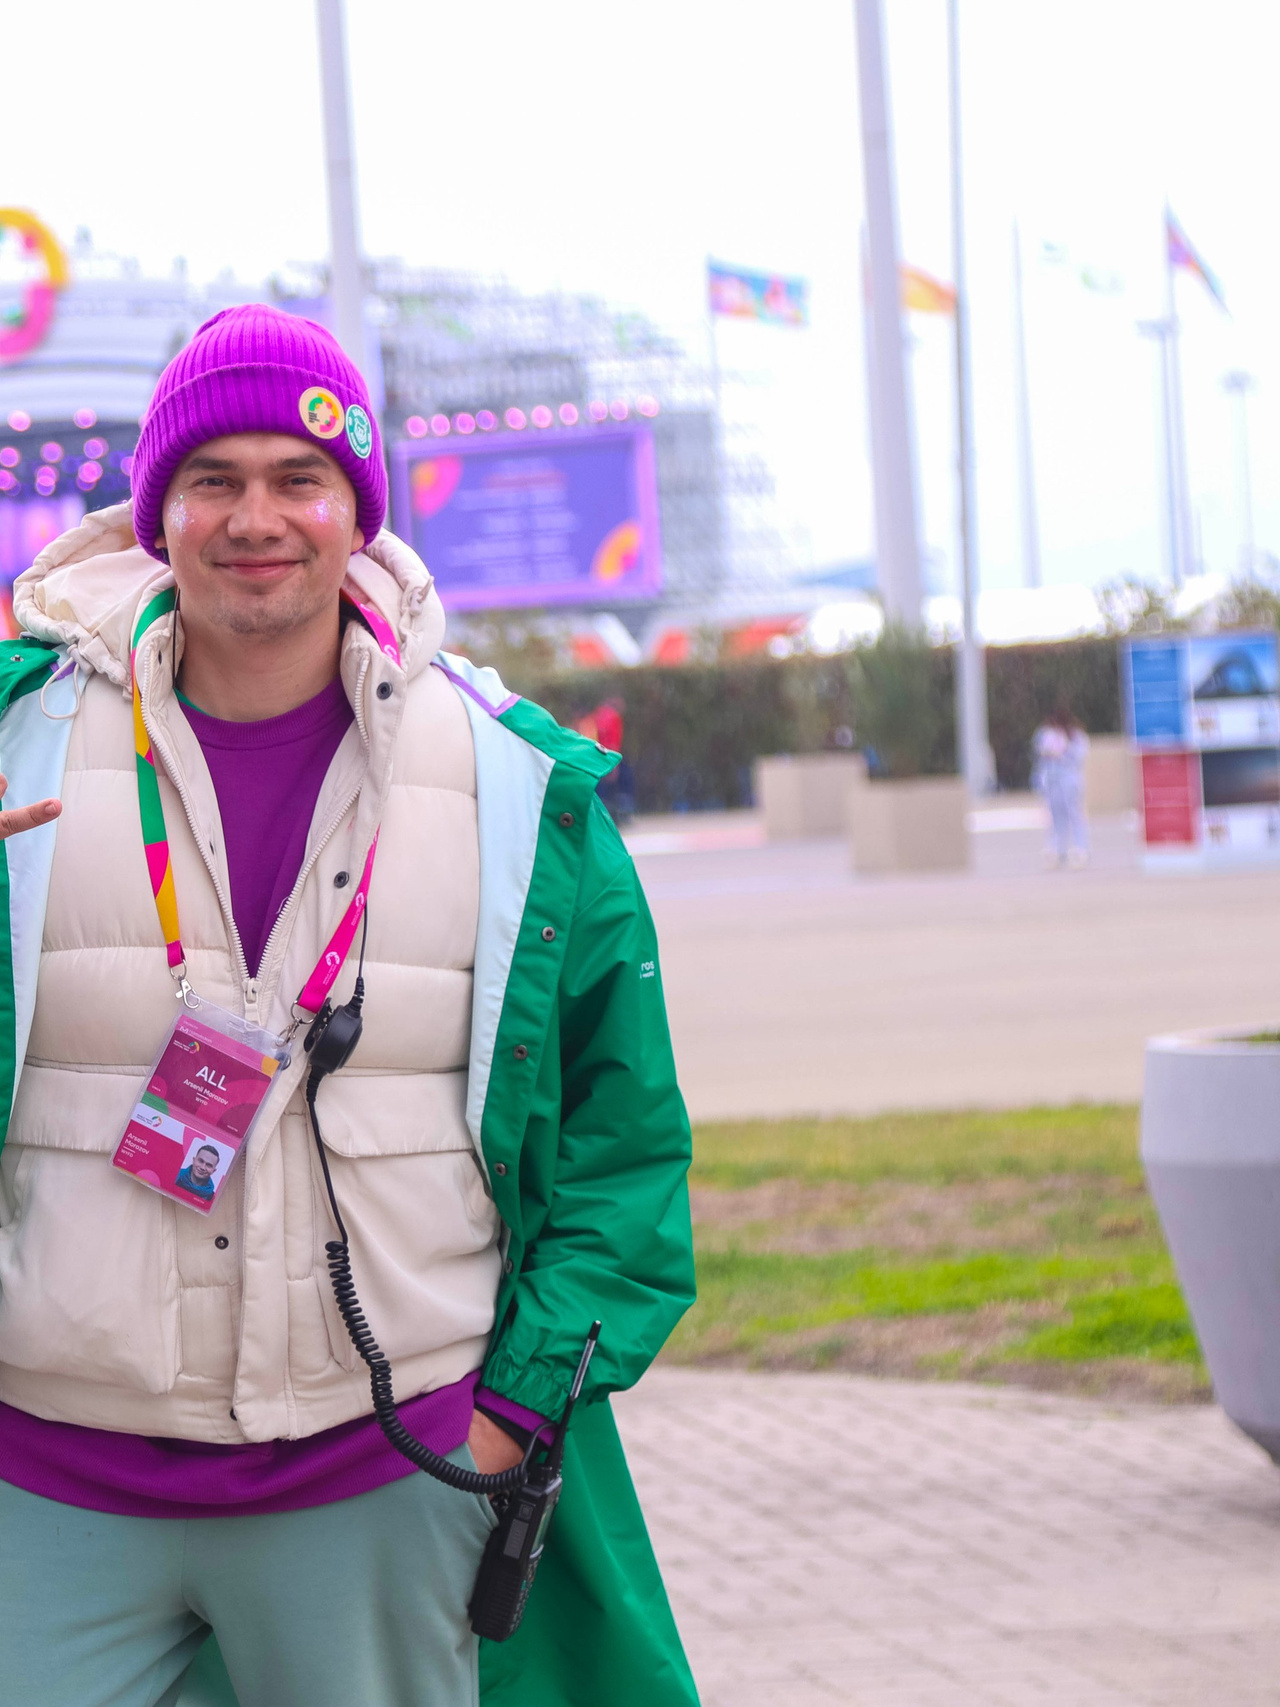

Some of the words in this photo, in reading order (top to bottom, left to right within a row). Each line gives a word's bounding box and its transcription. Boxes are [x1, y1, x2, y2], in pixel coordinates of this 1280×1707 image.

[195, 1065, 227, 1092] ALL
[183, 1079, 204, 1094] Arsenii
[203, 1087, 229, 1105] Morozov
[124, 1139, 150, 1155] Morozov
